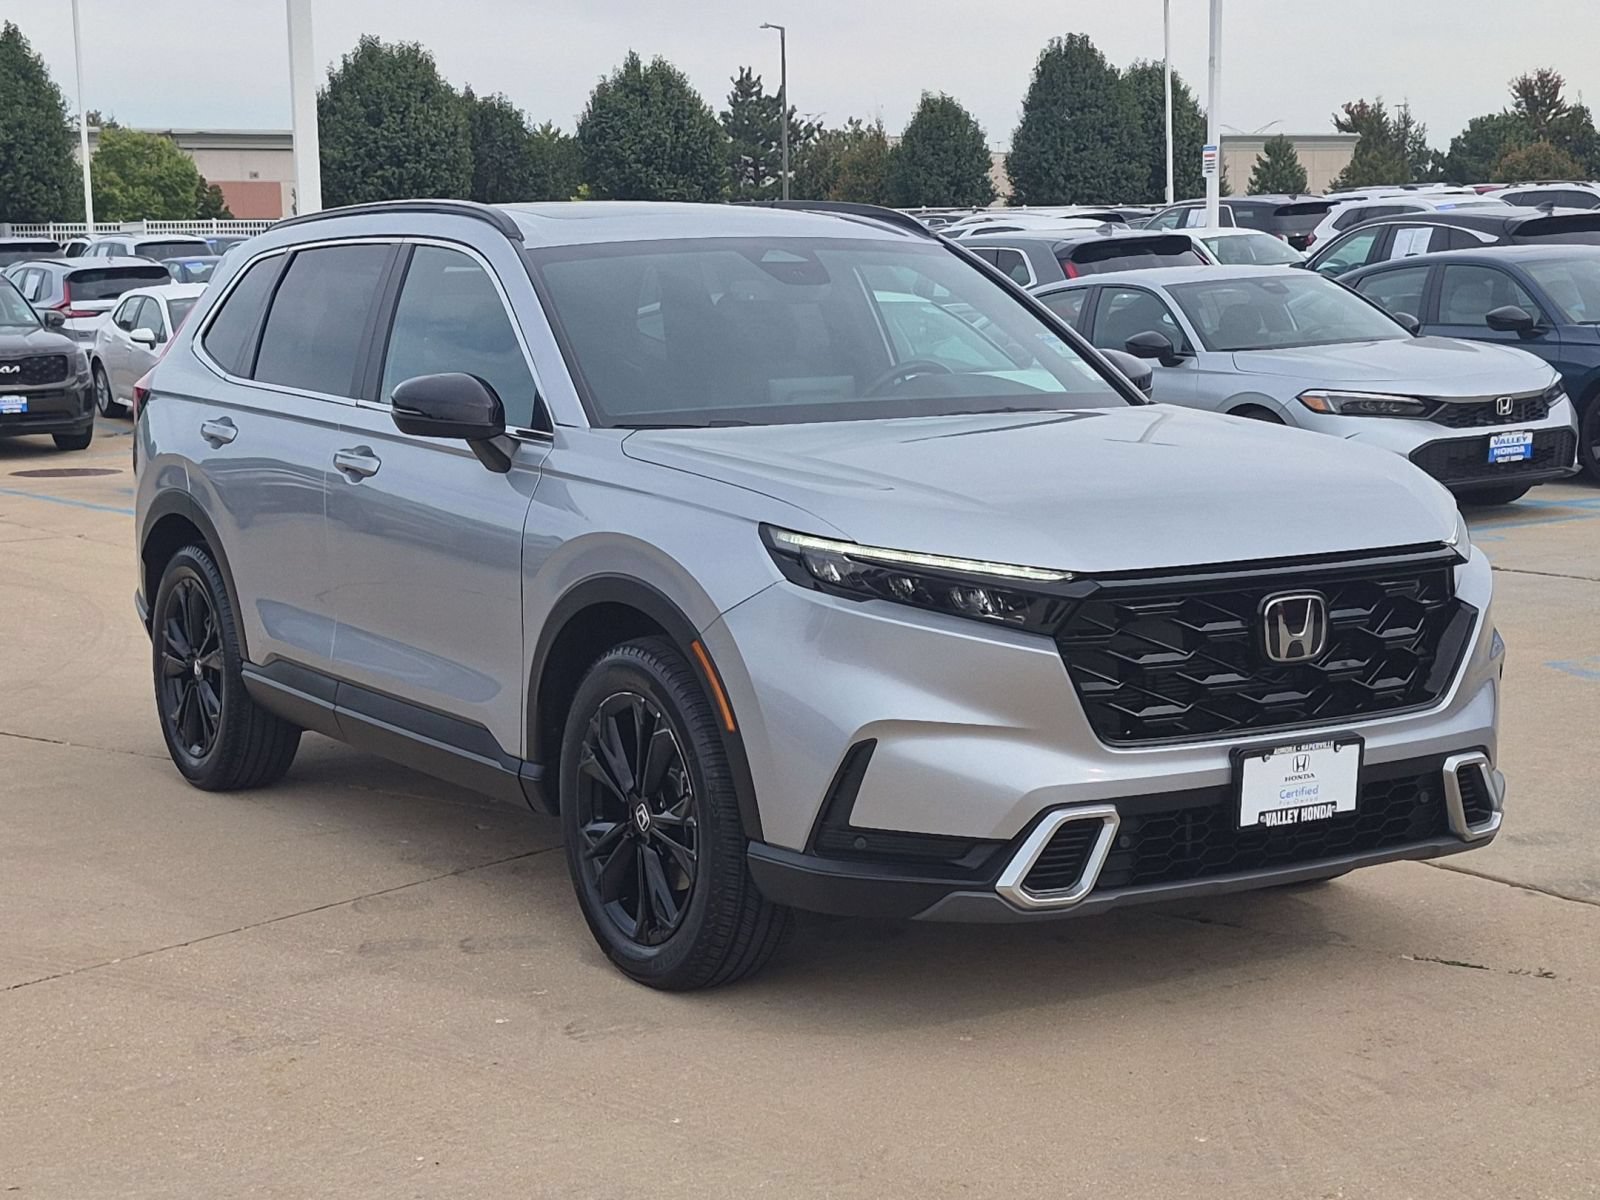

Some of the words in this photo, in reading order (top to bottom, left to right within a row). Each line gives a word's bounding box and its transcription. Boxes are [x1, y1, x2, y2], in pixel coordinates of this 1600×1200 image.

[1494, 436, 1528, 445] VALLEY
[1494, 445, 1525, 456] HONDA
[1284, 773, 1316, 782] HONDA
[1279, 784, 1319, 799] Certified
[1265, 808, 1300, 827] VALLEY
[1301, 804, 1333, 822] HONDA
